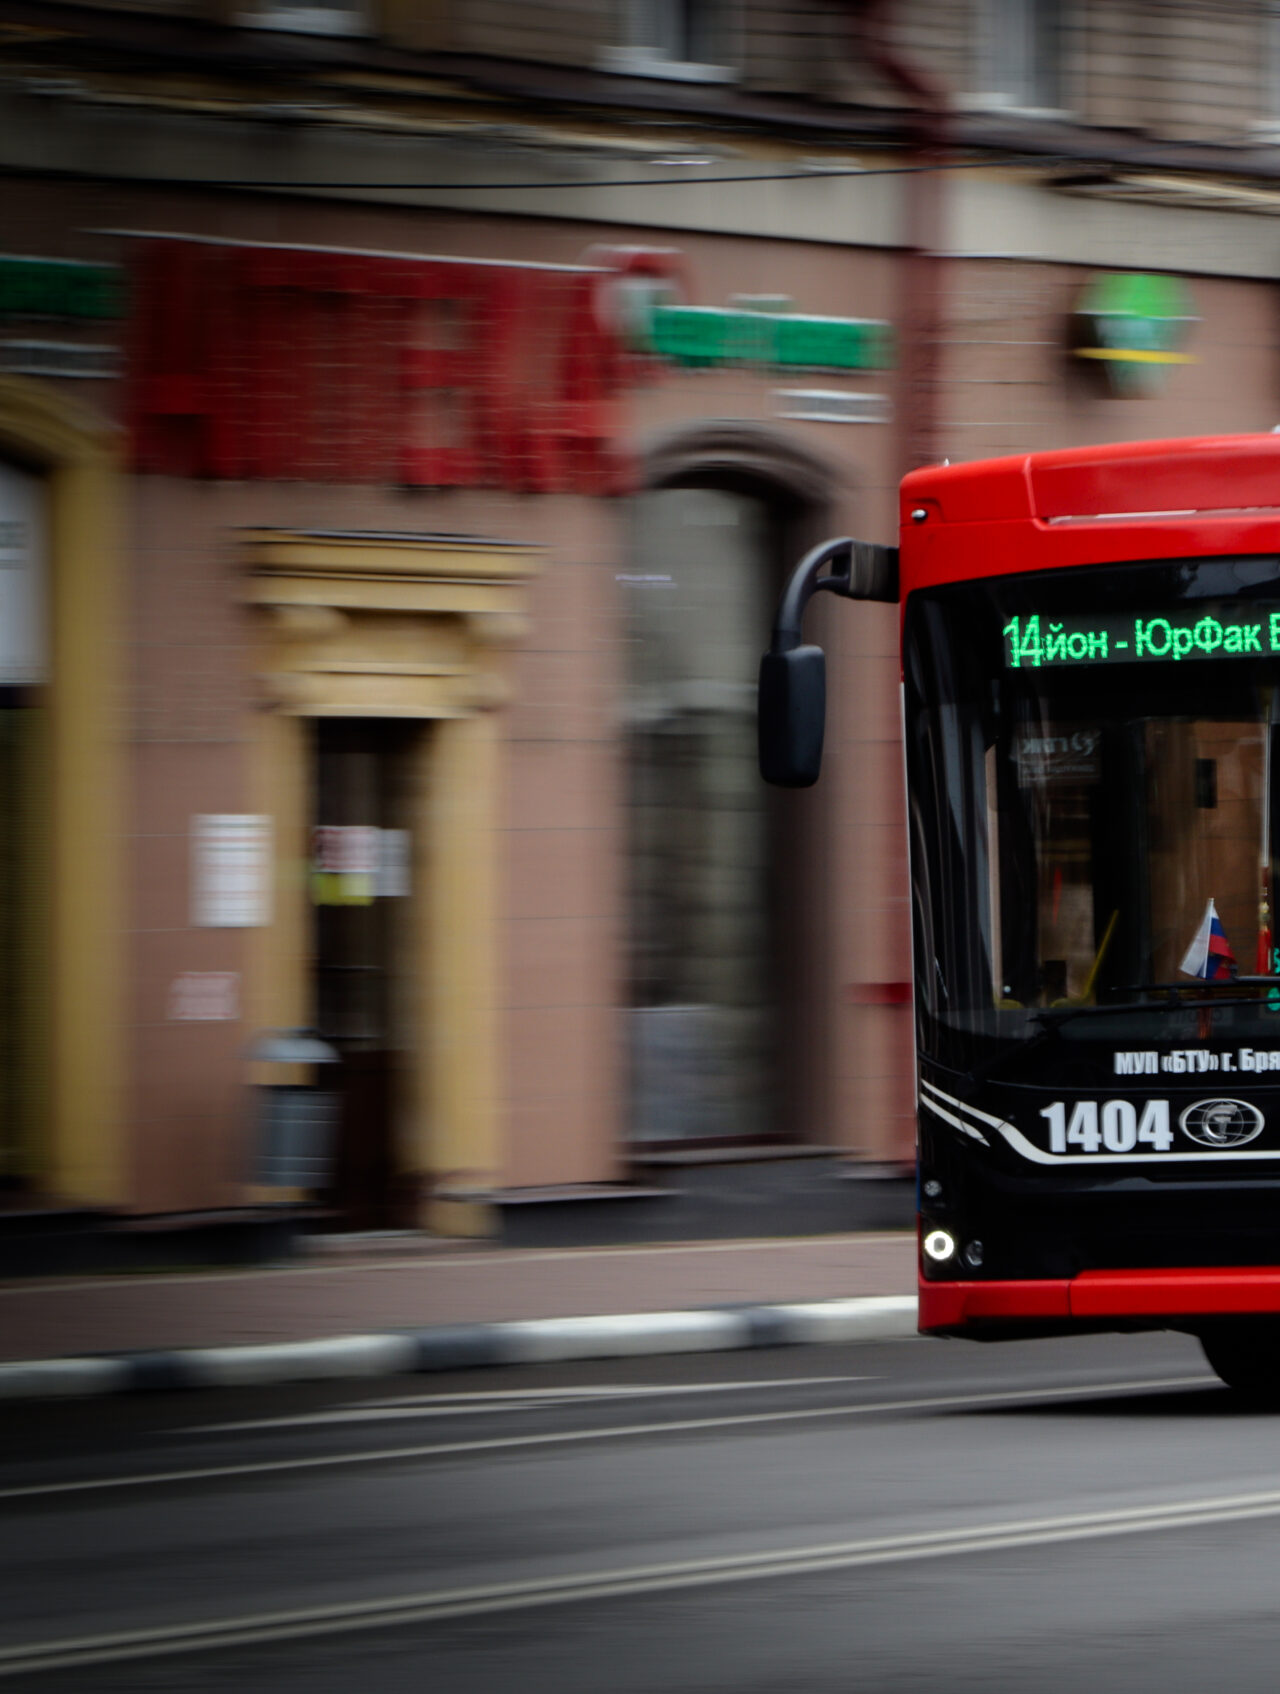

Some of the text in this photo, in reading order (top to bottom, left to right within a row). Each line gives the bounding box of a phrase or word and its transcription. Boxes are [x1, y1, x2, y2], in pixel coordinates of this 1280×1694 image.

[1135, 616, 1262, 661] ЮрФак
[1114, 1051, 1159, 1074] МУП
[1220, 1052, 1238, 1072] г.
[1039, 1099, 1174, 1152] 1404
